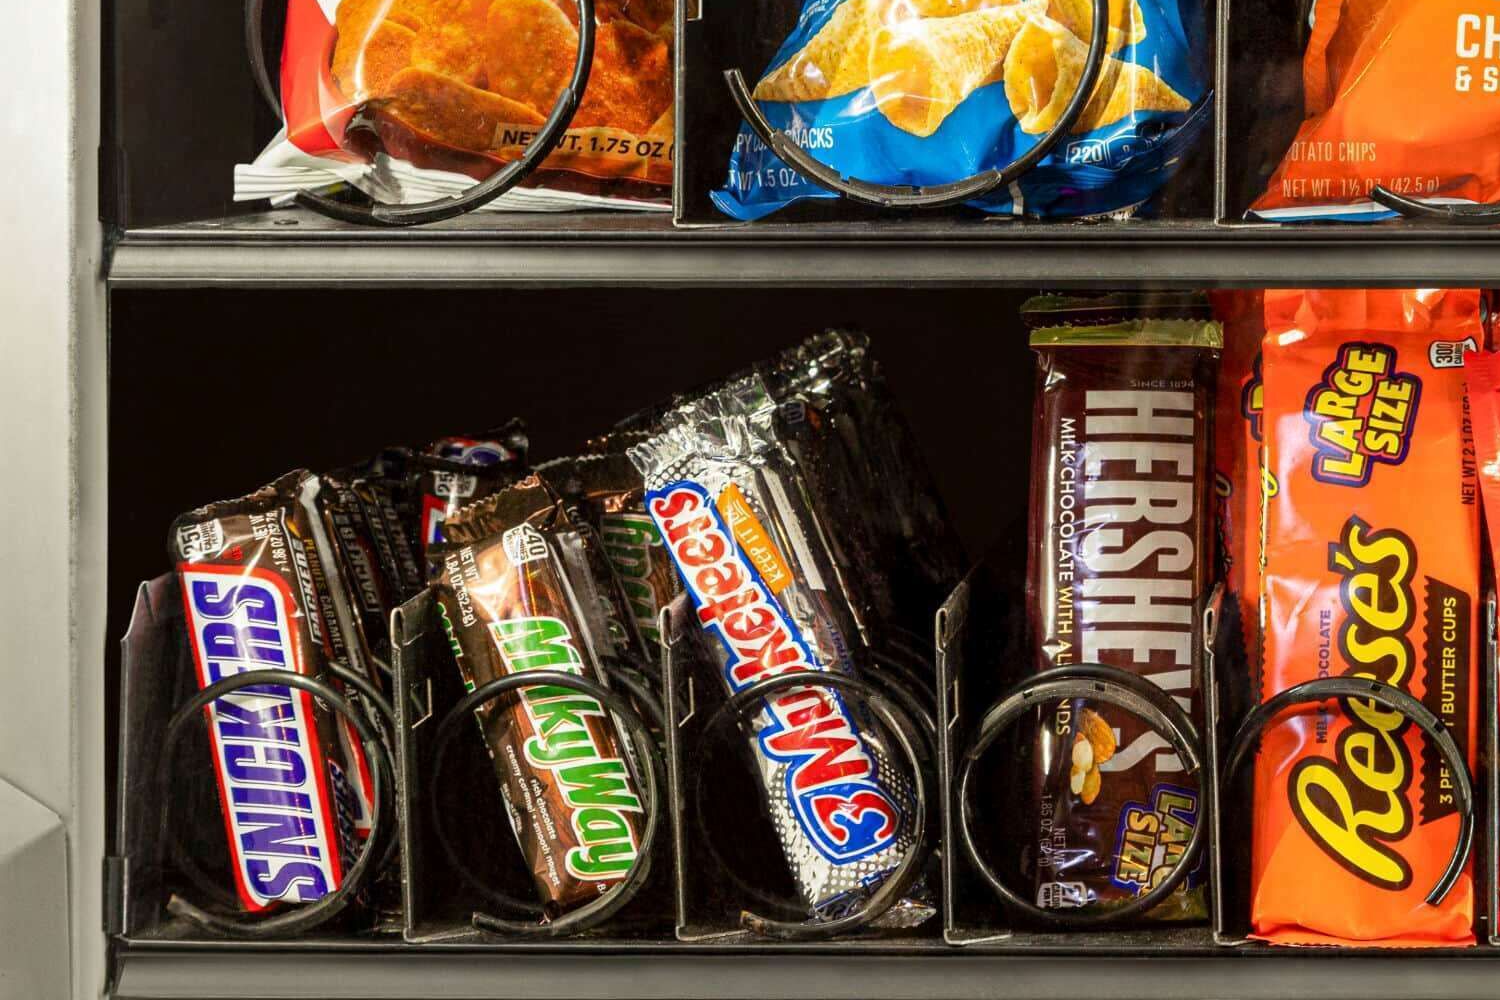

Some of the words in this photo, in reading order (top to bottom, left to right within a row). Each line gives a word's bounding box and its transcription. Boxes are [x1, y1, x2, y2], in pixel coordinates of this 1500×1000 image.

[1455, 65, 1472, 93] &
[588, 136, 632, 155] 1.75
[635, 140, 665, 158] OZ
[1070, 144, 1103, 164] 220
[1338, 141, 1377, 163] CHIPS
[1282, 177, 1307, 198] NET
[1311, 178, 1336, 198] WT.
[1435, 343, 1454, 365] 300
[1129, 380, 1166, 389] SINCE
[1321, 347, 1390, 476] LARGE
[1367, 376, 1415, 456] SIZE
[1059, 417, 1077, 463] MILK
[1461, 459, 1476, 479] WT
[1461, 481, 1476, 505] NET
[522, 522, 547, 556] 240
[1057, 464, 1076, 583] CHOCOLATE
[459, 546, 476, 567] NET
[464, 566, 481, 583] WT
[757, 540, 790, 585] KEEP
[450, 574, 465, 590] OZ
[1084, 389, 1196, 774] HERSHEYS
[1055, 585, 1074, 635] WITH
[1442, 596, 1458, 642] CUPS
[1294, 523, 1411, 884] Reese's
[1440, 648, 1458, 714] BUTTER
[191, 578, 330, 902] SNICKERS
[505, 743, 522, 777] creamy
[518, 777, 535, 813] caramel
[532, 821, 551, 856] smooth
[545, 855, 561, 887] nougat
[530, 778, 543, 798] rich
[537, 798, 557, 840] chocolate
[810, 791, 898, 849] 3
[1439, 794, 1453, 805] 3
[1119, 810, 1159, 884] SIZE
